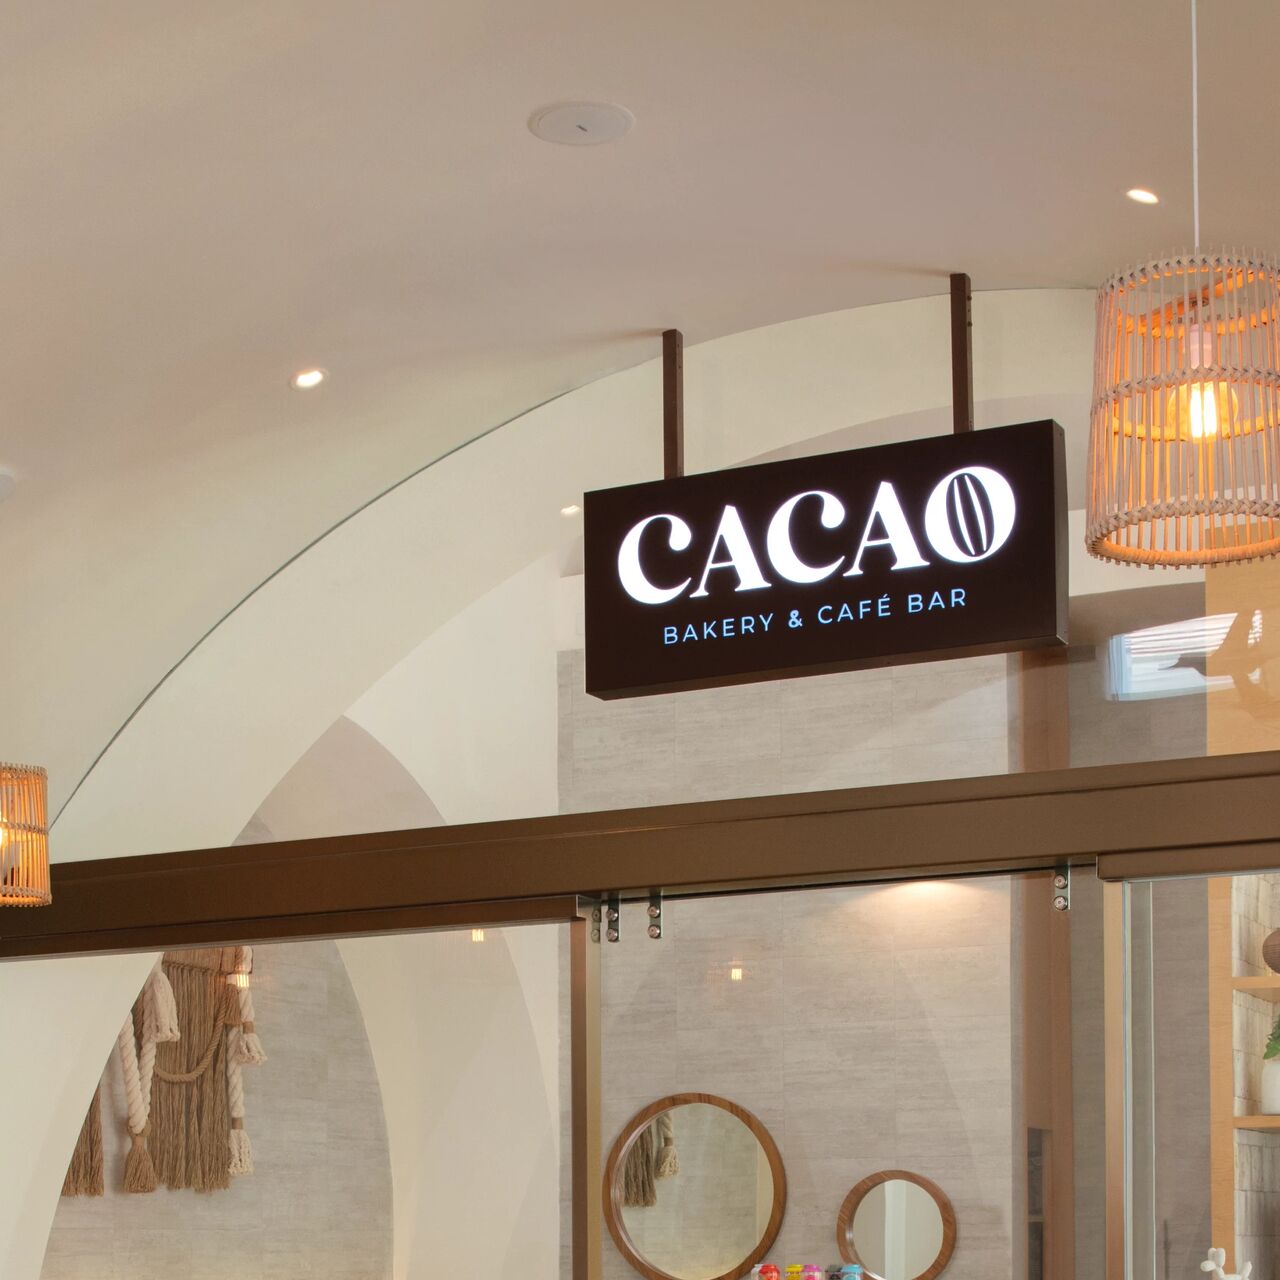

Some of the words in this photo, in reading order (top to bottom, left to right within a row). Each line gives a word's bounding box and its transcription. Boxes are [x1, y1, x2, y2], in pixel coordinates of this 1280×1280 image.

[617, 465, 1017, 605] CACAO
[663, 612, 774, 645] BAKERY
[787, 609, 803, 628] &
[817, 593, 891, 625] CAFÉ
[907, 588, 966, 613] BAR
